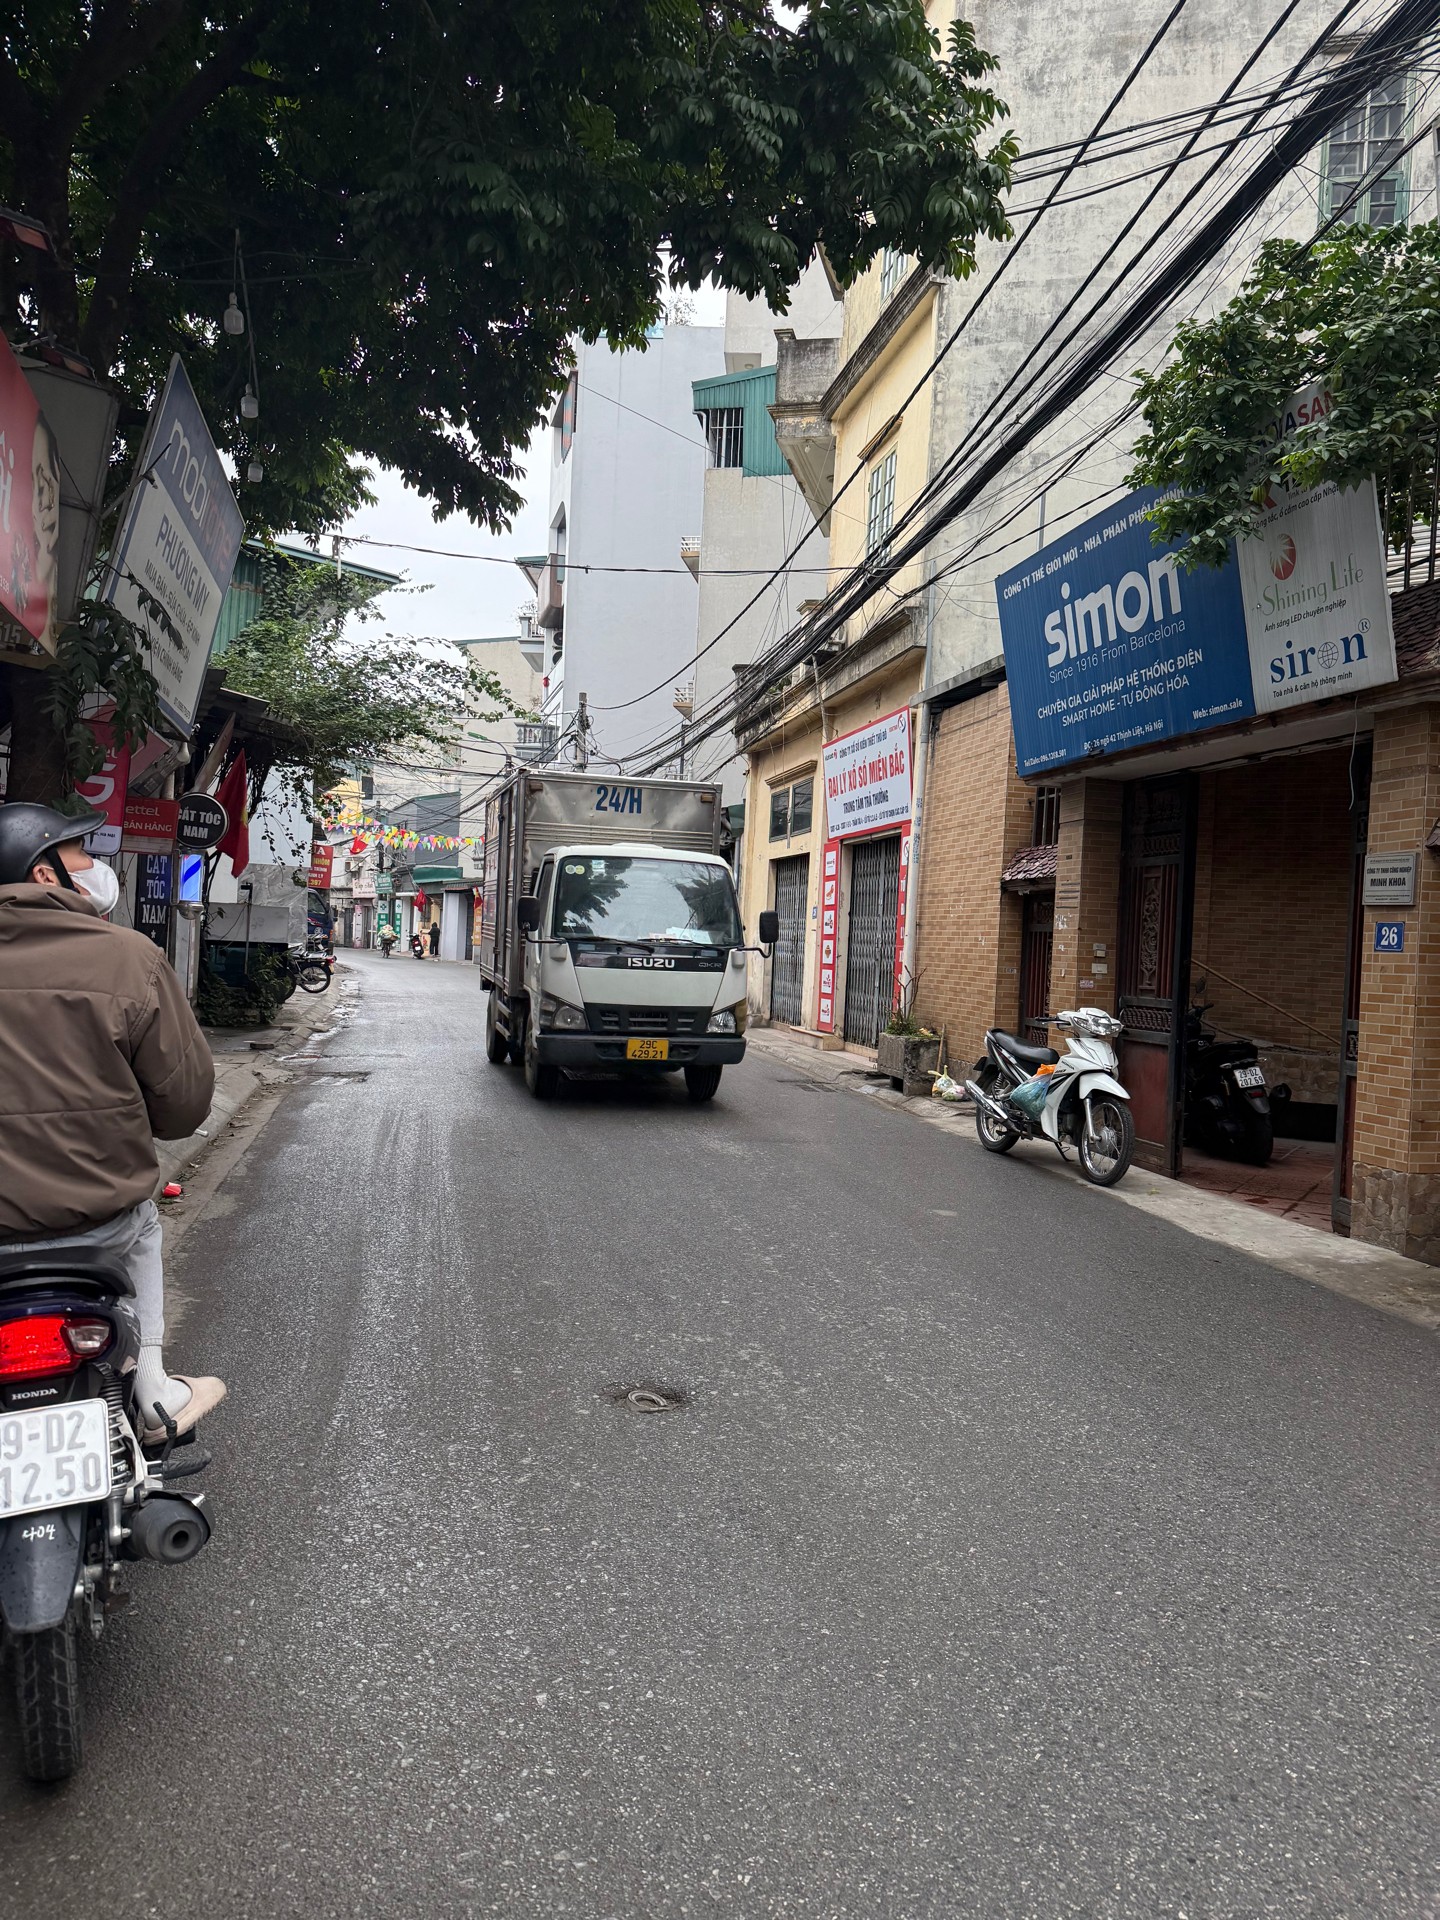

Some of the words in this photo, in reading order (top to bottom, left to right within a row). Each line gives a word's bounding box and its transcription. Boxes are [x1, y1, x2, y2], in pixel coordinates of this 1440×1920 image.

[1004, 581, 1021, 600] CÔNG
[1022, 577, 1030, 590] TY
[1031, 564, 1044, 583] THẾ
[1046, 556, 1061, 574] GIỚI
[1062, 547, 1078, 566] MỚI
[1084, 532, 1102, 553] NHÀ
[1103, 517, 1127, 542] PHÂN
[1262, 582, 1327, 616] Shining
[1330, 553, 1364, 592] Life
[1044, 549, 1182, 668] simon
[1290, 614, 1302, 623] LED
[1050, 666, 1074, 684] Since
[1076, 653, 1098, 672] 1916
[1101, 642, 1127, 662] From
[1130, 620, 1186, 650] Barcelona
[1038, 698, 1067, 720] CHUYÊN
[1068, 694, 1082, 710] GIA
[1082, 684, 1100, 705] GIẢI
[1101, 674, 1124, 699] PHÁP
[1126, 670, 1139, 690] HỆ
[1140, 656, 1175, 684] THỐNG
[1176, 648, 1203, 672] ĐIỆN
[1062, 710, 1088, 727] SMART
[1090, 703, 1116, 720] HOME
[1121, 694, 1134, 714] TỰ
[1135, 682, 1164, 704] ĐỘNG
[1167, 674, 1190, 692] HÓA
[1192, 708, 1208, 720] Web:
[828, 775, 838, 802] ĐẠI
[840, 768, 846, 795] LÝ
[869, 751, 888, 785] MIỀN
[890, 743, 905, 778] BẮC
[596, 784, 642, 814] 24/H
[183, 825, 208, 839] NAM
[146, 877, 164, 899] TÓC
[1370, 878, 1387, 886] MINH
[1388, 877, 1406, 886] KHOA
[142, 906, 166, 924] NAM
[1380, 926, 1397, 945] 26
[627, 958, 675, 968] ISUZU
[631, 1050, 663, 1059] 429.21
[640, 1040, 657, 1049] 29C
[12, 1388, 58, 1400] HONDA
[0, 1410, 86, 1460] 9-D2
